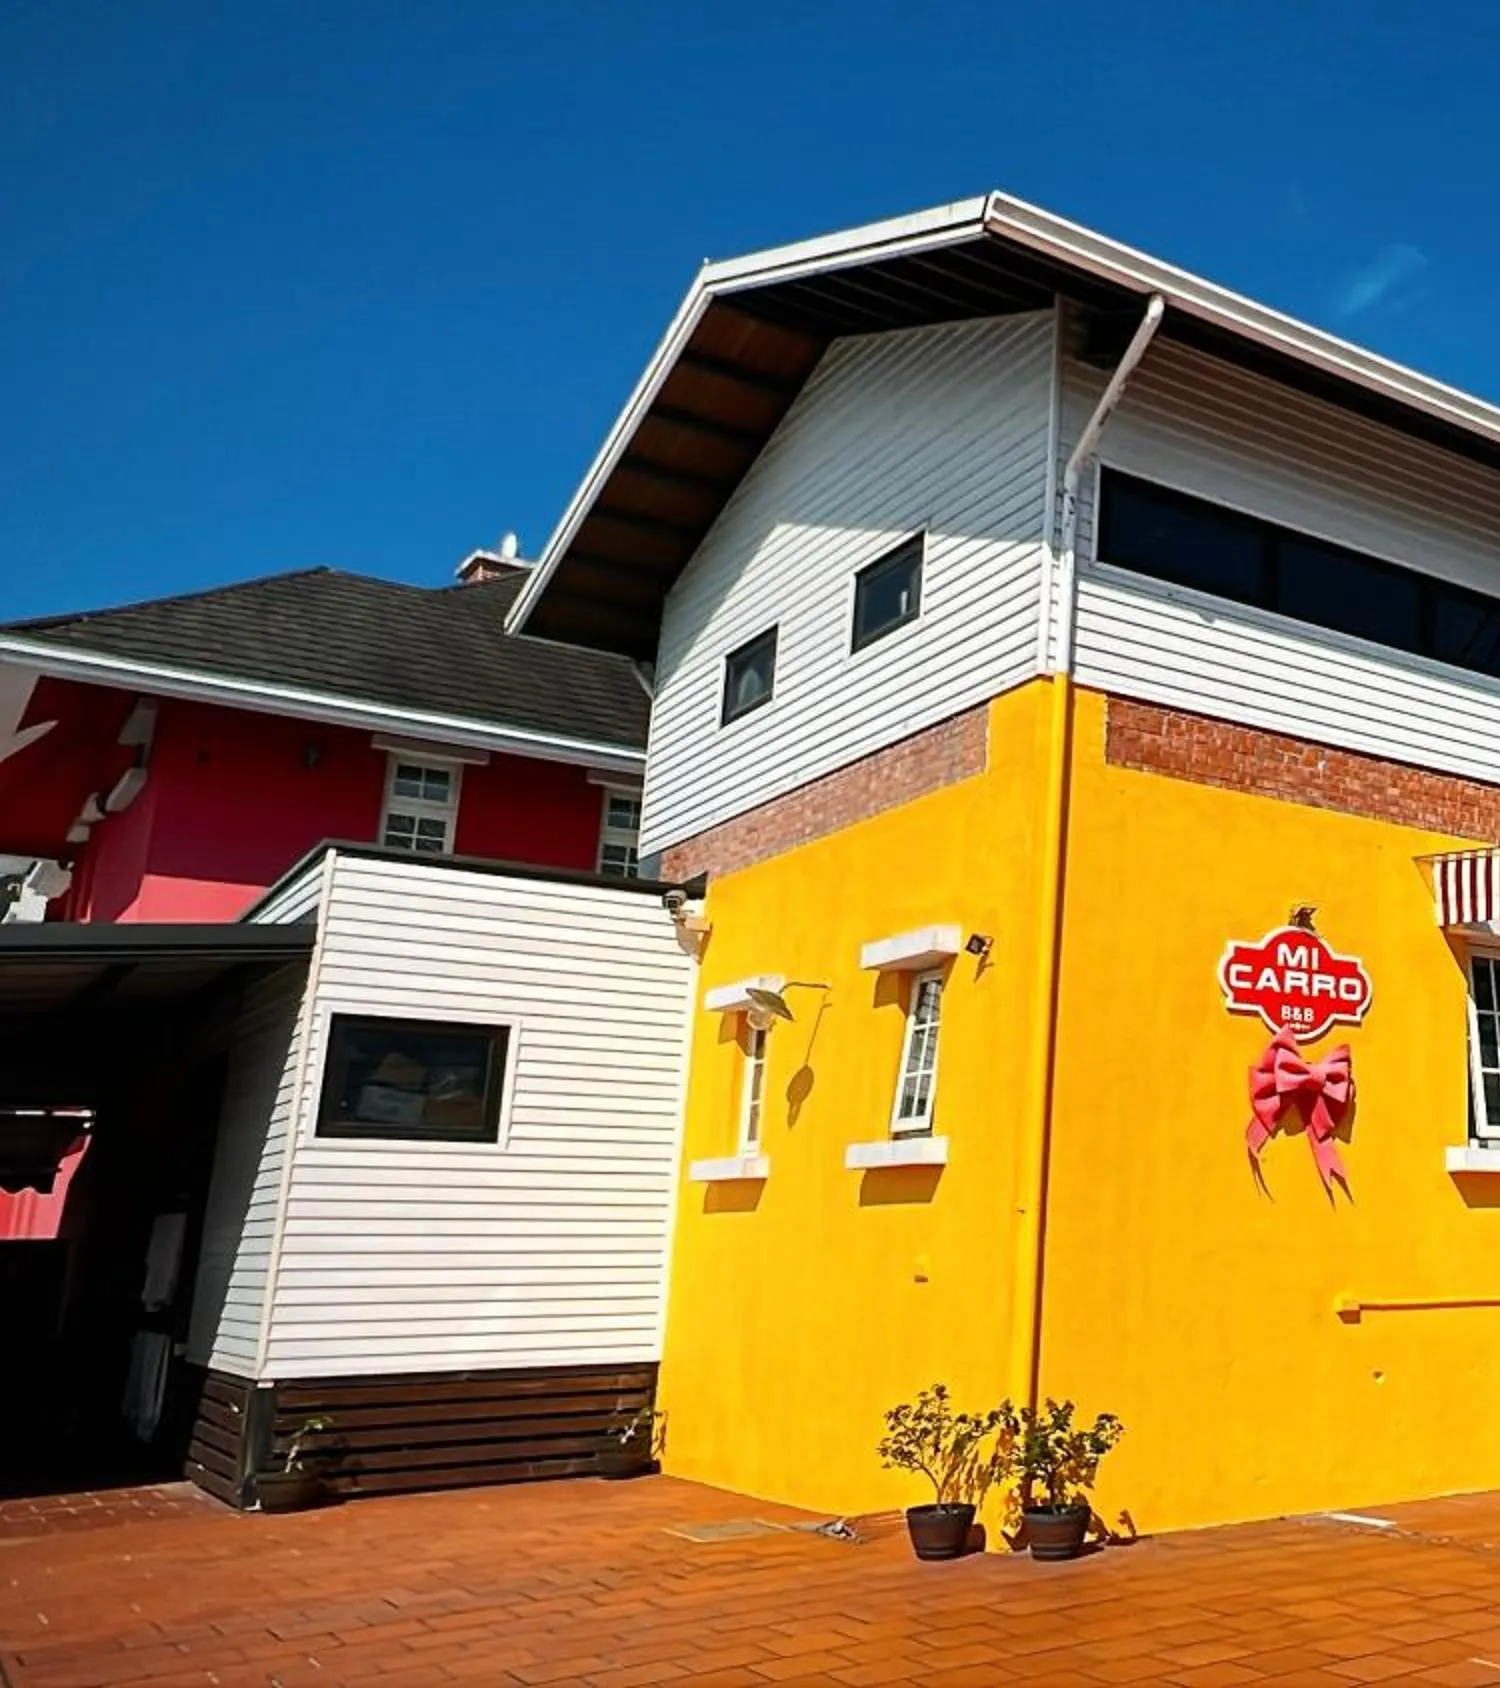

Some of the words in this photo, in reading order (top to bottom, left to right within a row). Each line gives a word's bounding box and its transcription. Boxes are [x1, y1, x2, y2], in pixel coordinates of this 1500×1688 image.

[1277, 943, 1319, 971] MI
[1229, 963, 1362, 1001] CARRO
[1281, 1005, 1315, 1022] B&B
